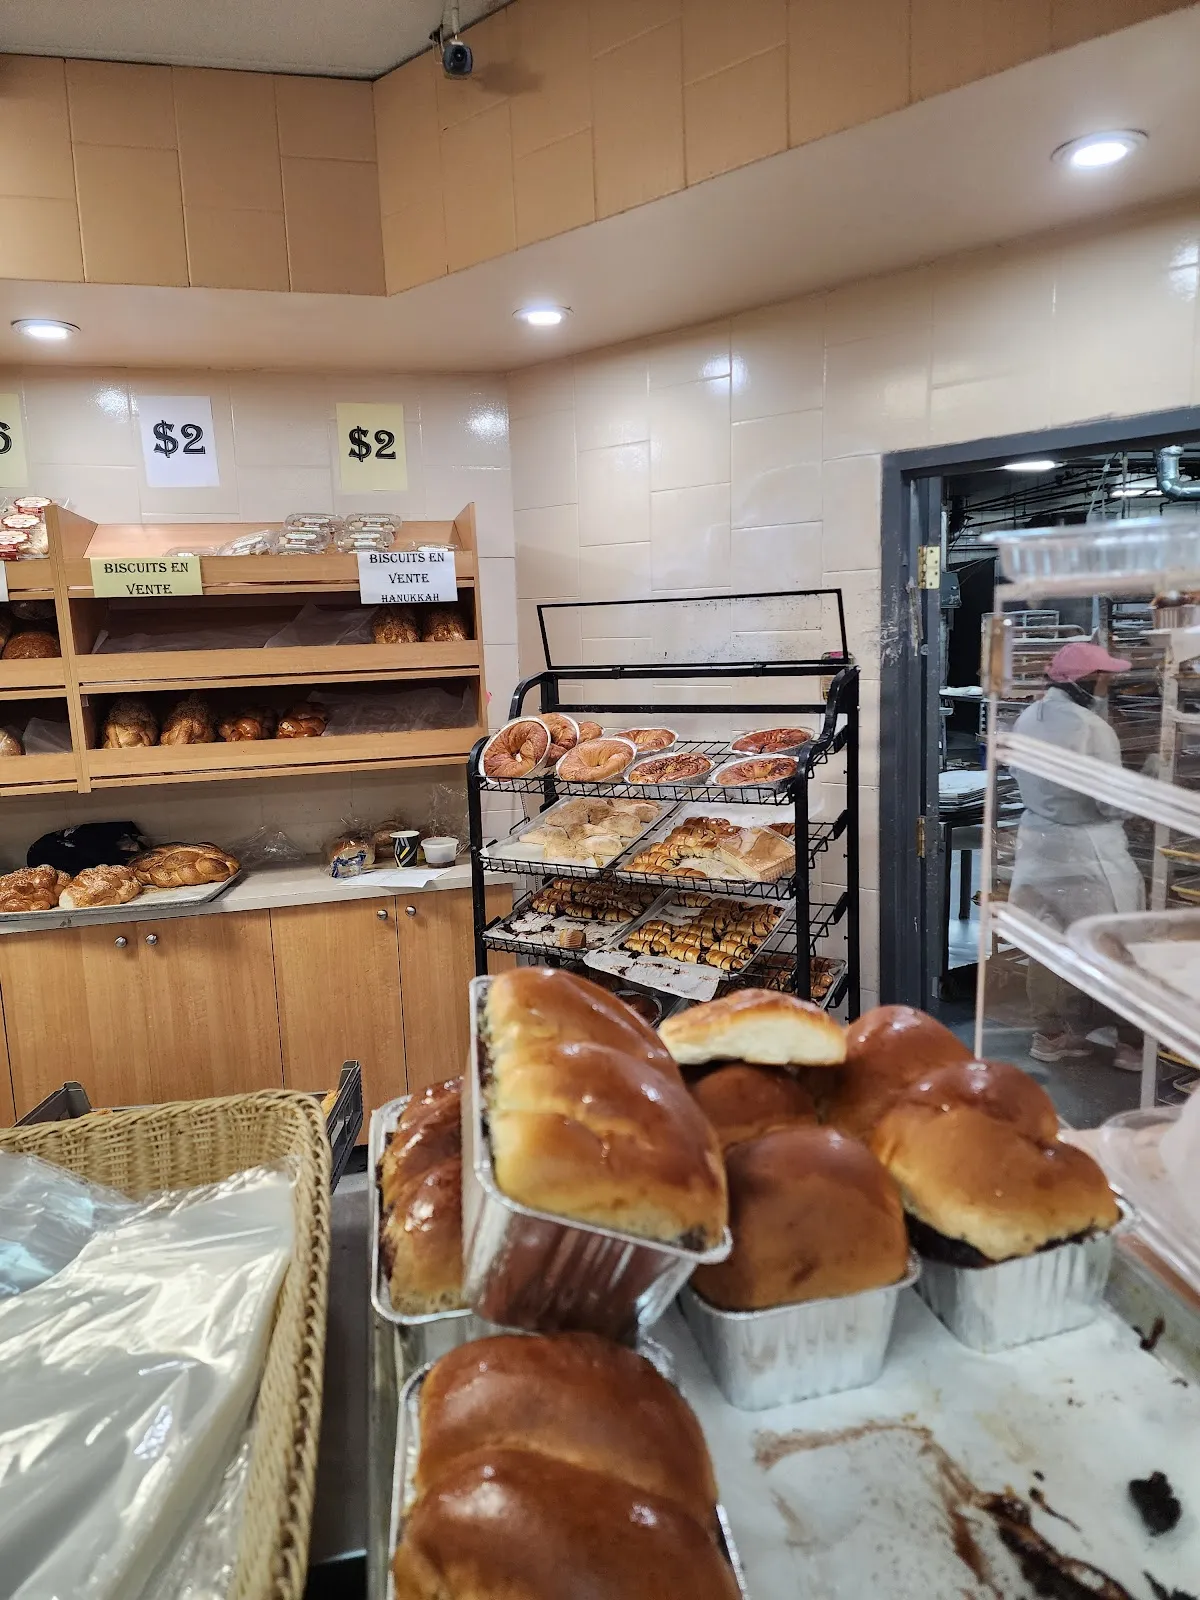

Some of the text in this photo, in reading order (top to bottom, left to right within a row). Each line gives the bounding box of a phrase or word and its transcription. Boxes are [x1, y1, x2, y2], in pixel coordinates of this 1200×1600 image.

[153, 419, 206, 458] $2
[347, 425, 397, 462] $2
[369, 552, 445, 564] BISCUITS EN
[104, 562, 189, 574] BISCUITS EN
[388, 572, 430, 584] VENTE
[126, 583, 172, 595] VENTE
[381, 593, 440, 603] HANUKKAH
